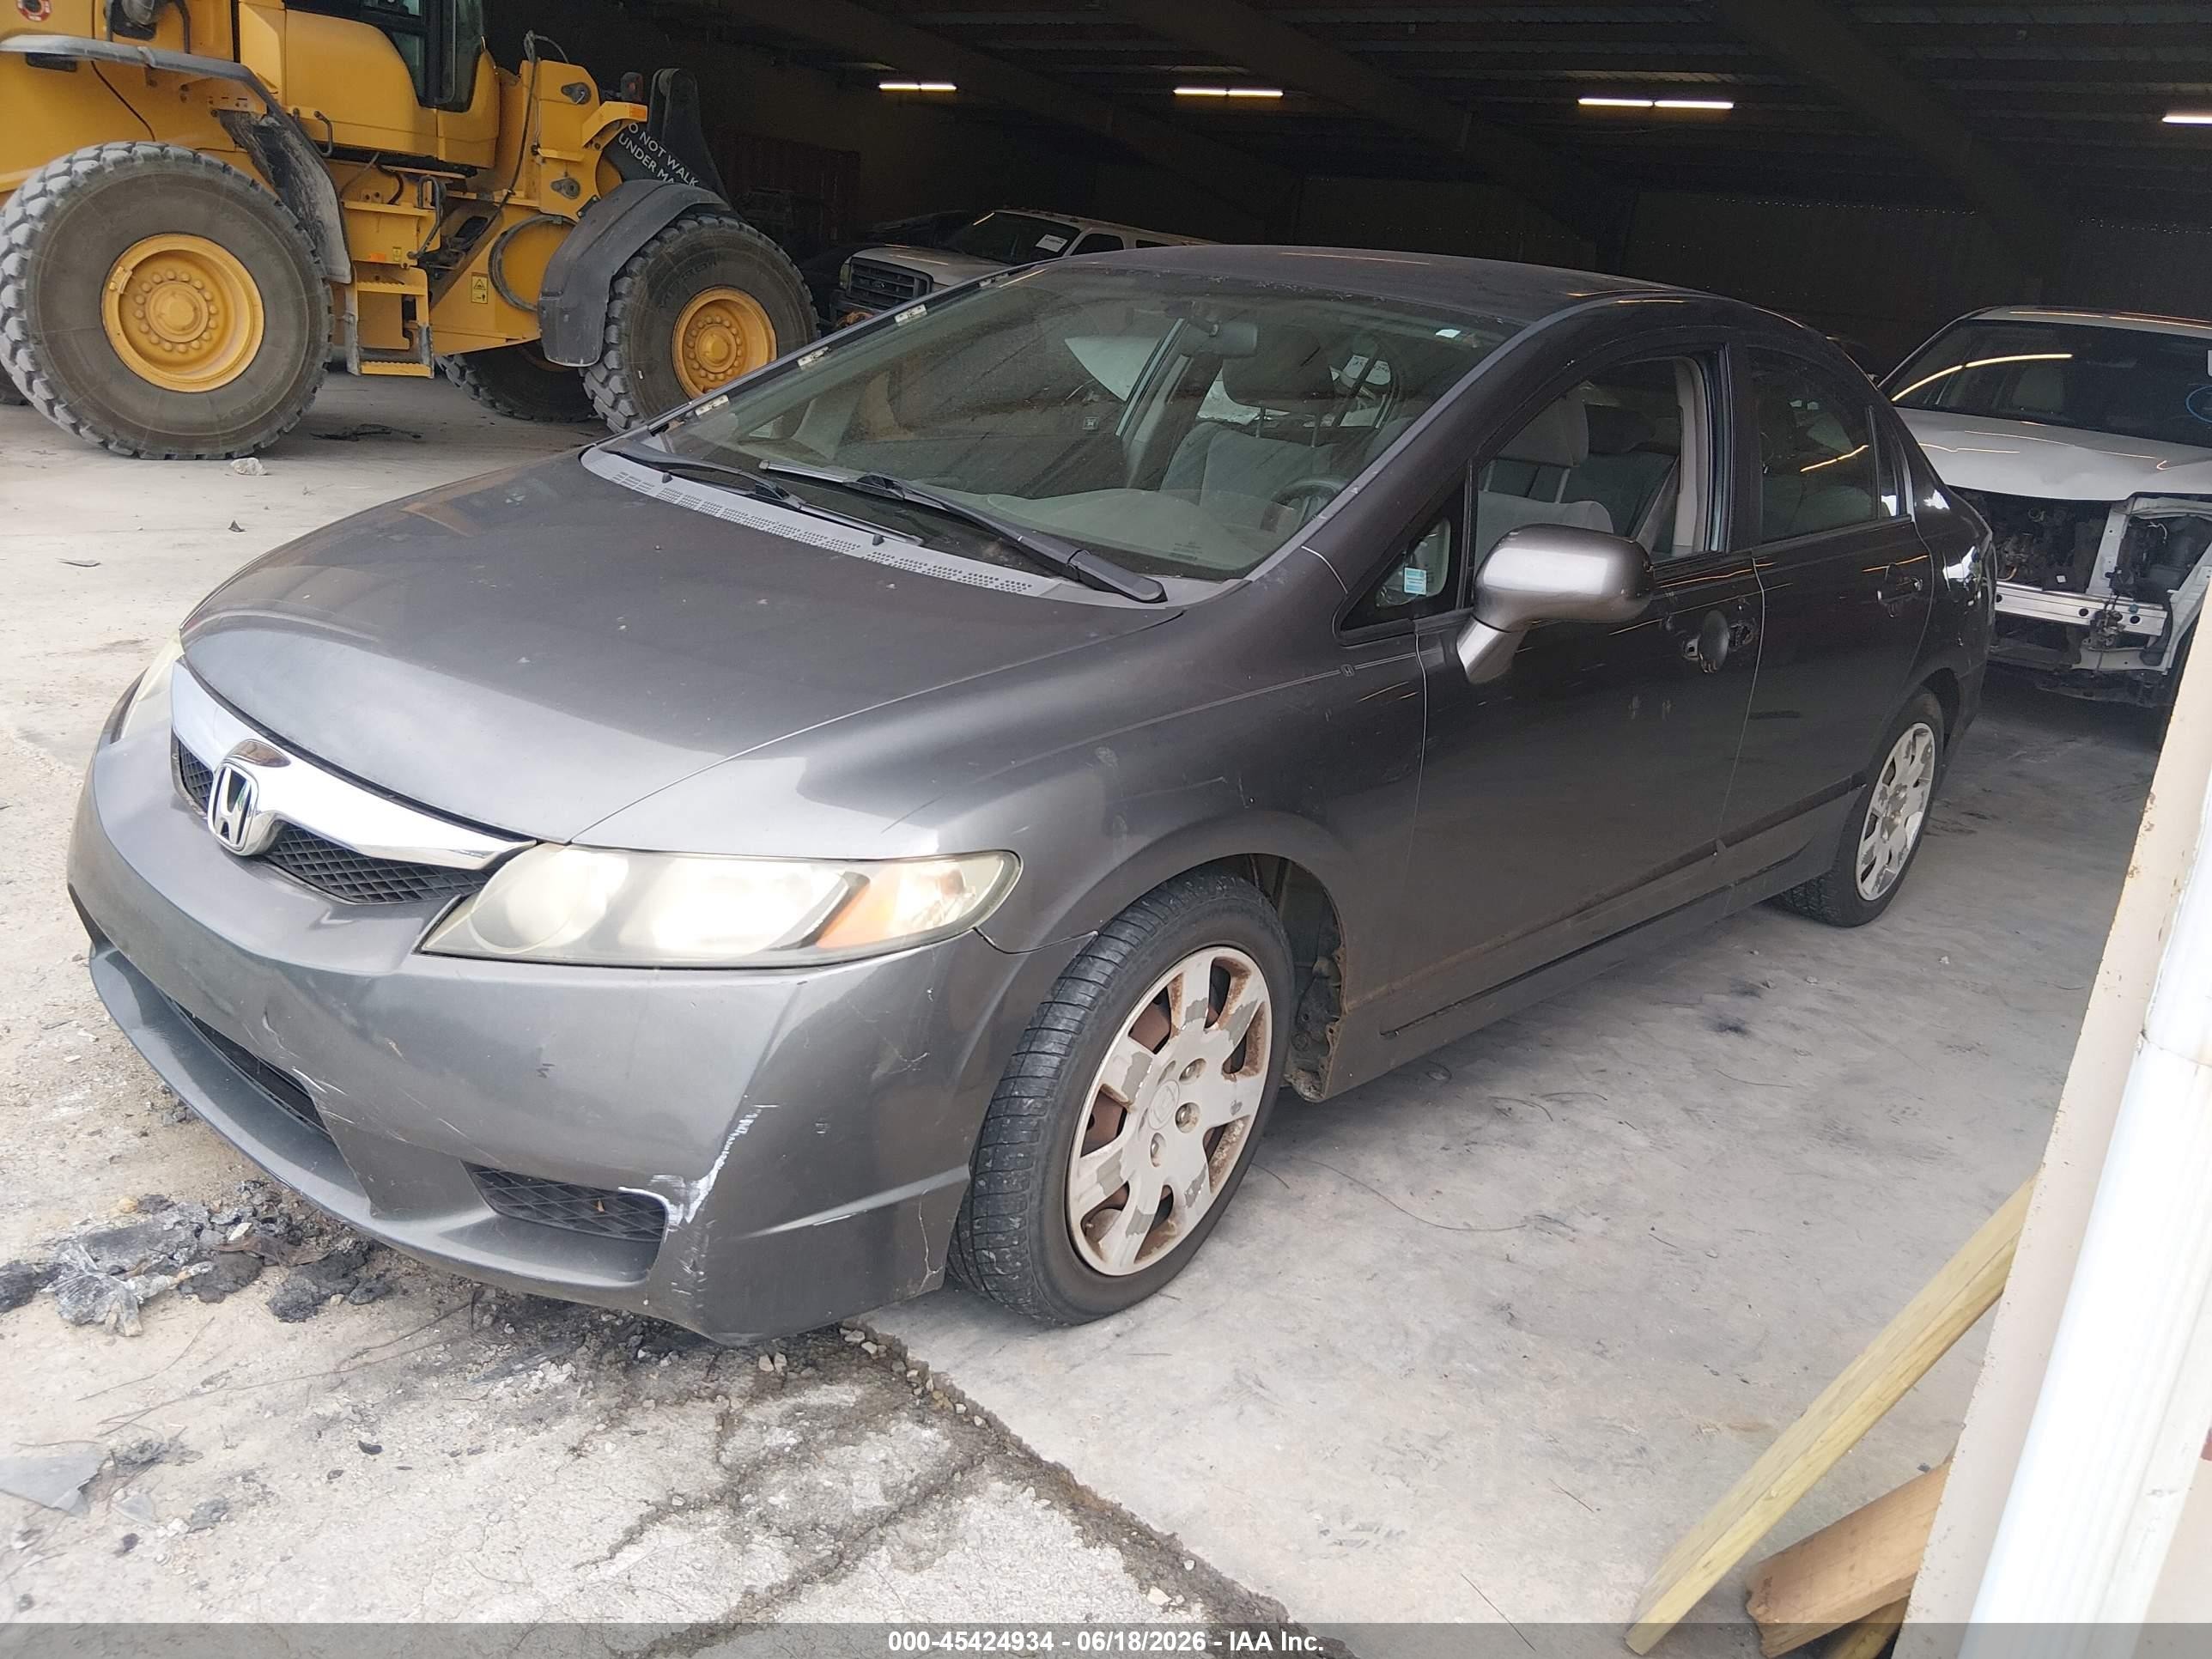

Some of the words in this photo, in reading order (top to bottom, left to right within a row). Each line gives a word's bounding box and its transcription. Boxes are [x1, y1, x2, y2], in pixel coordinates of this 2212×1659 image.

[618, 133, 657, 173] UNDER
[628, 123, 639, 134] O
[639, 131, 666, 158] NOT
[666, 155, 700, 186] WALK
